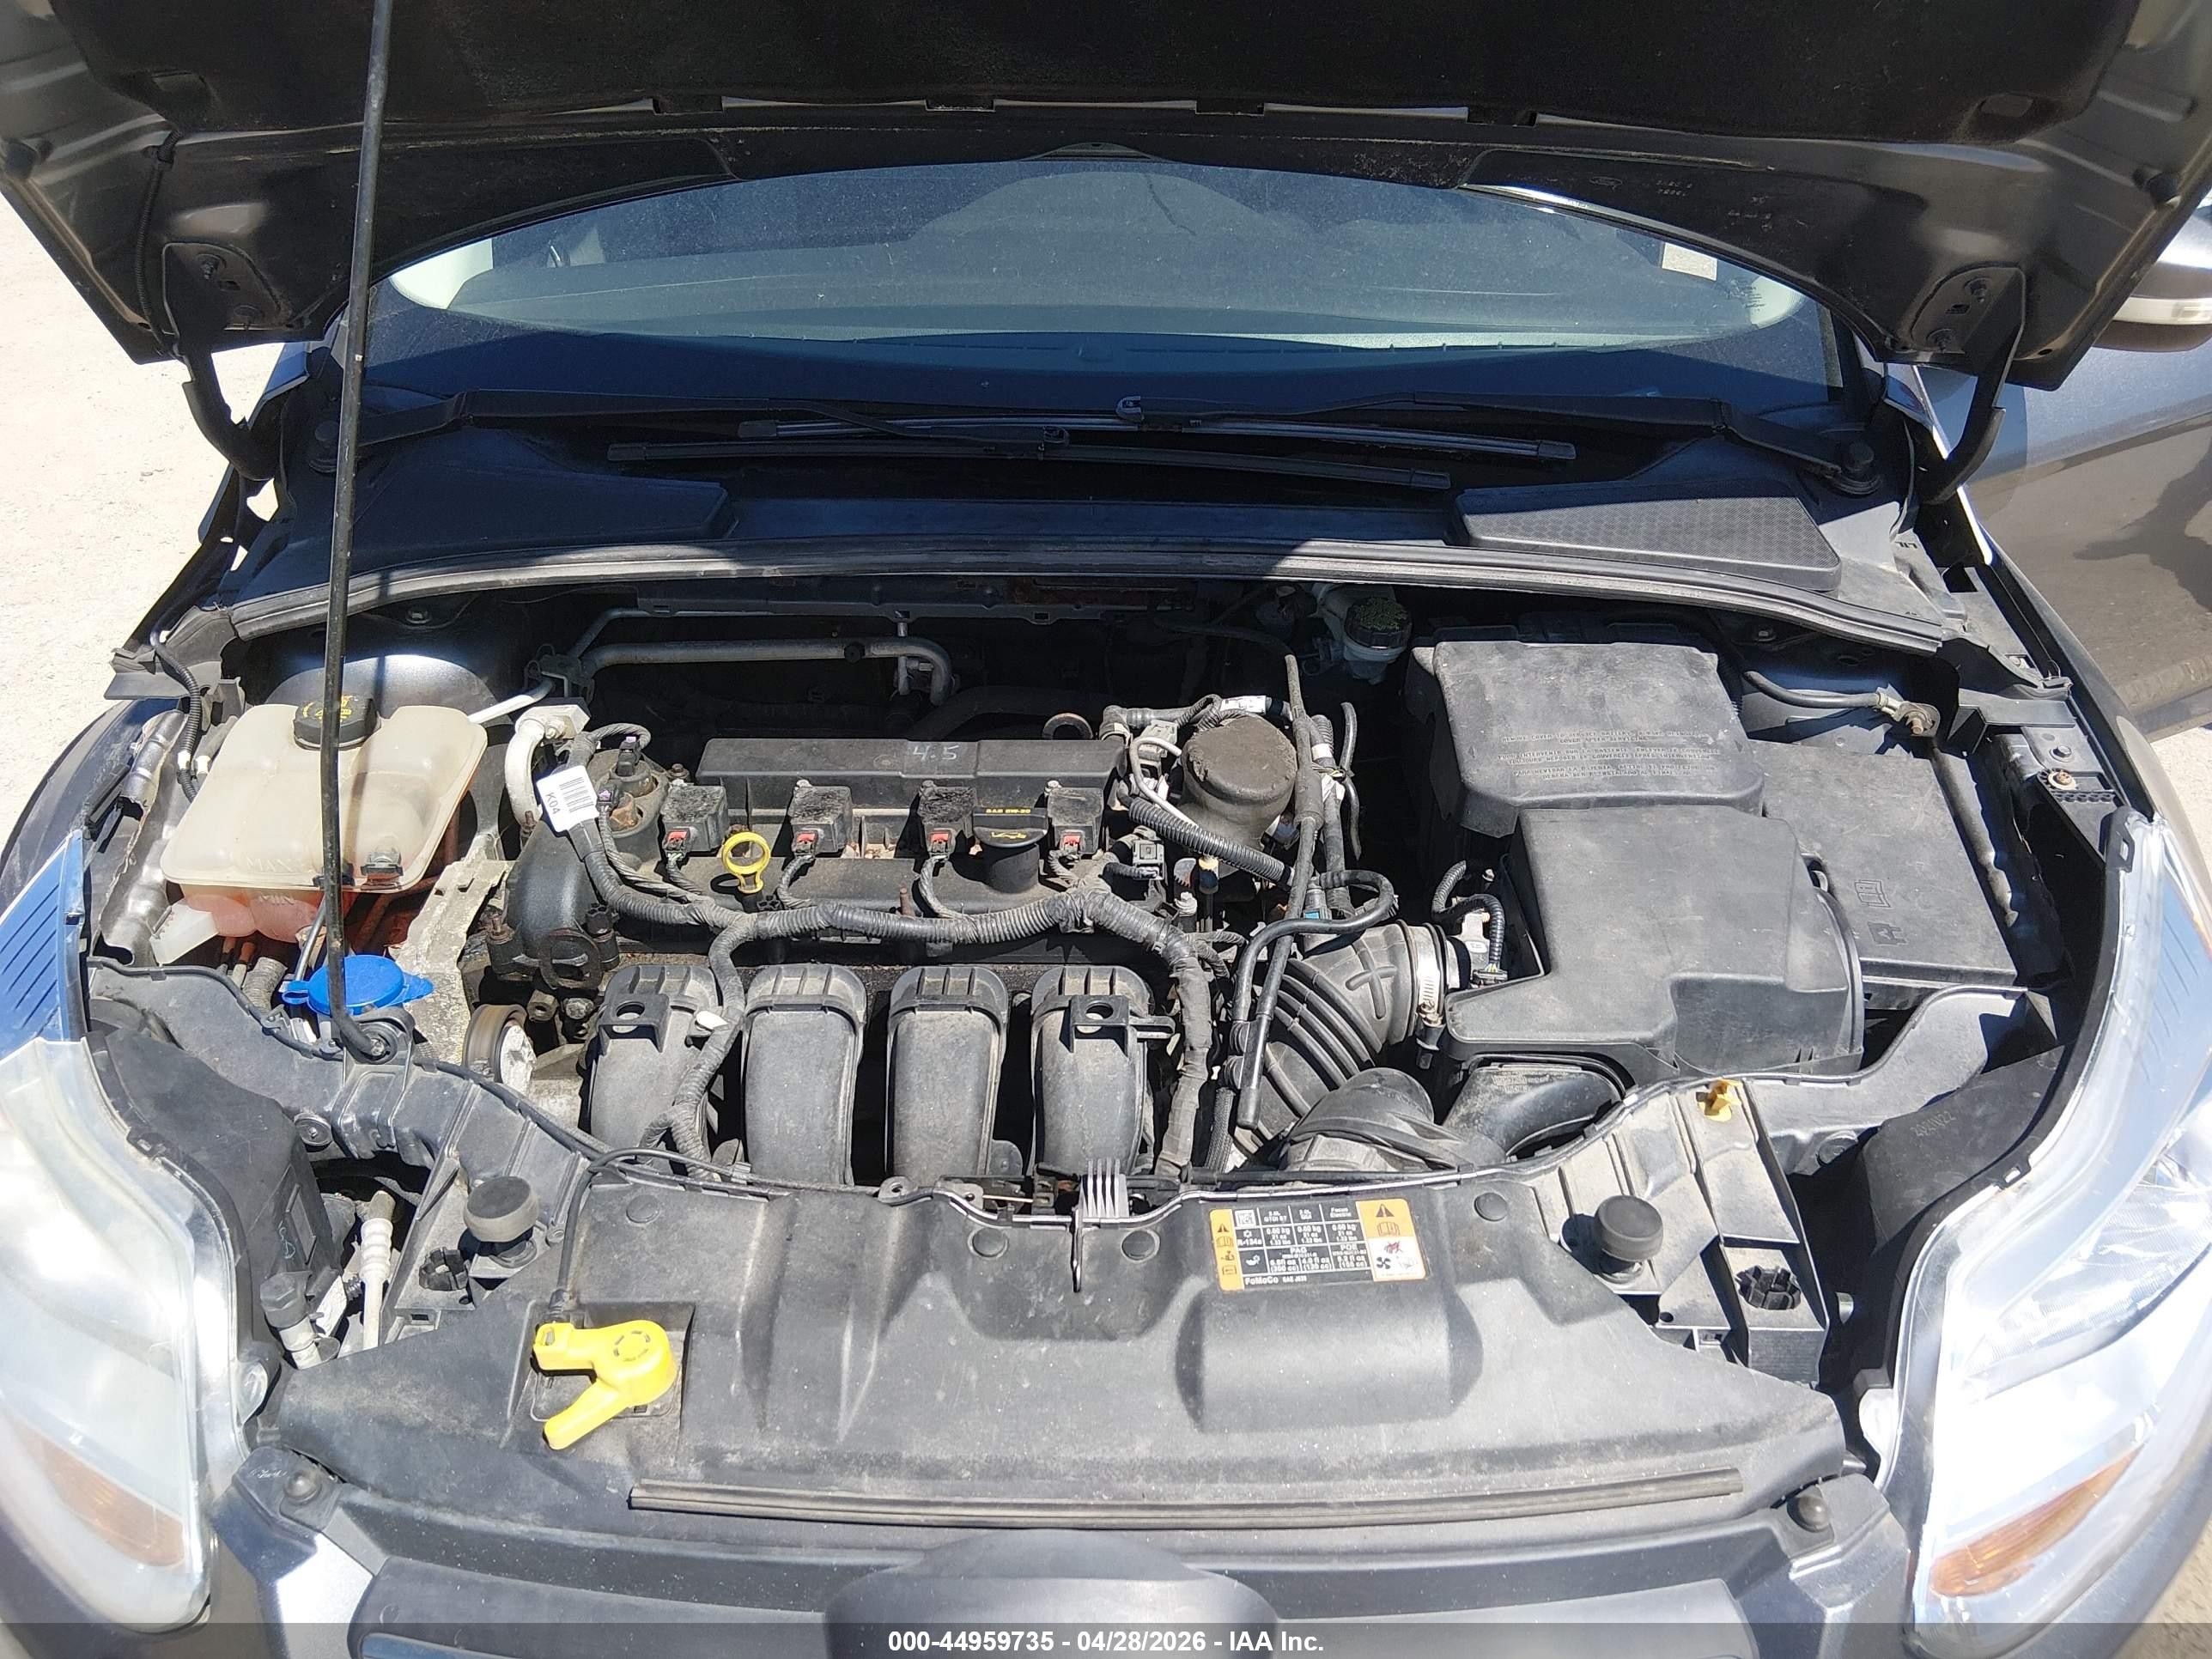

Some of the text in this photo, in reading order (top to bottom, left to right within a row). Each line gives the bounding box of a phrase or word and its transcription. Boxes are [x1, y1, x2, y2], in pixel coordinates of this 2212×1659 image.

[545, 792, 562, 815] K04
[259, 893, 295, 906] MIN
[1245, 1276, 1279, 1285] FoMoCo
